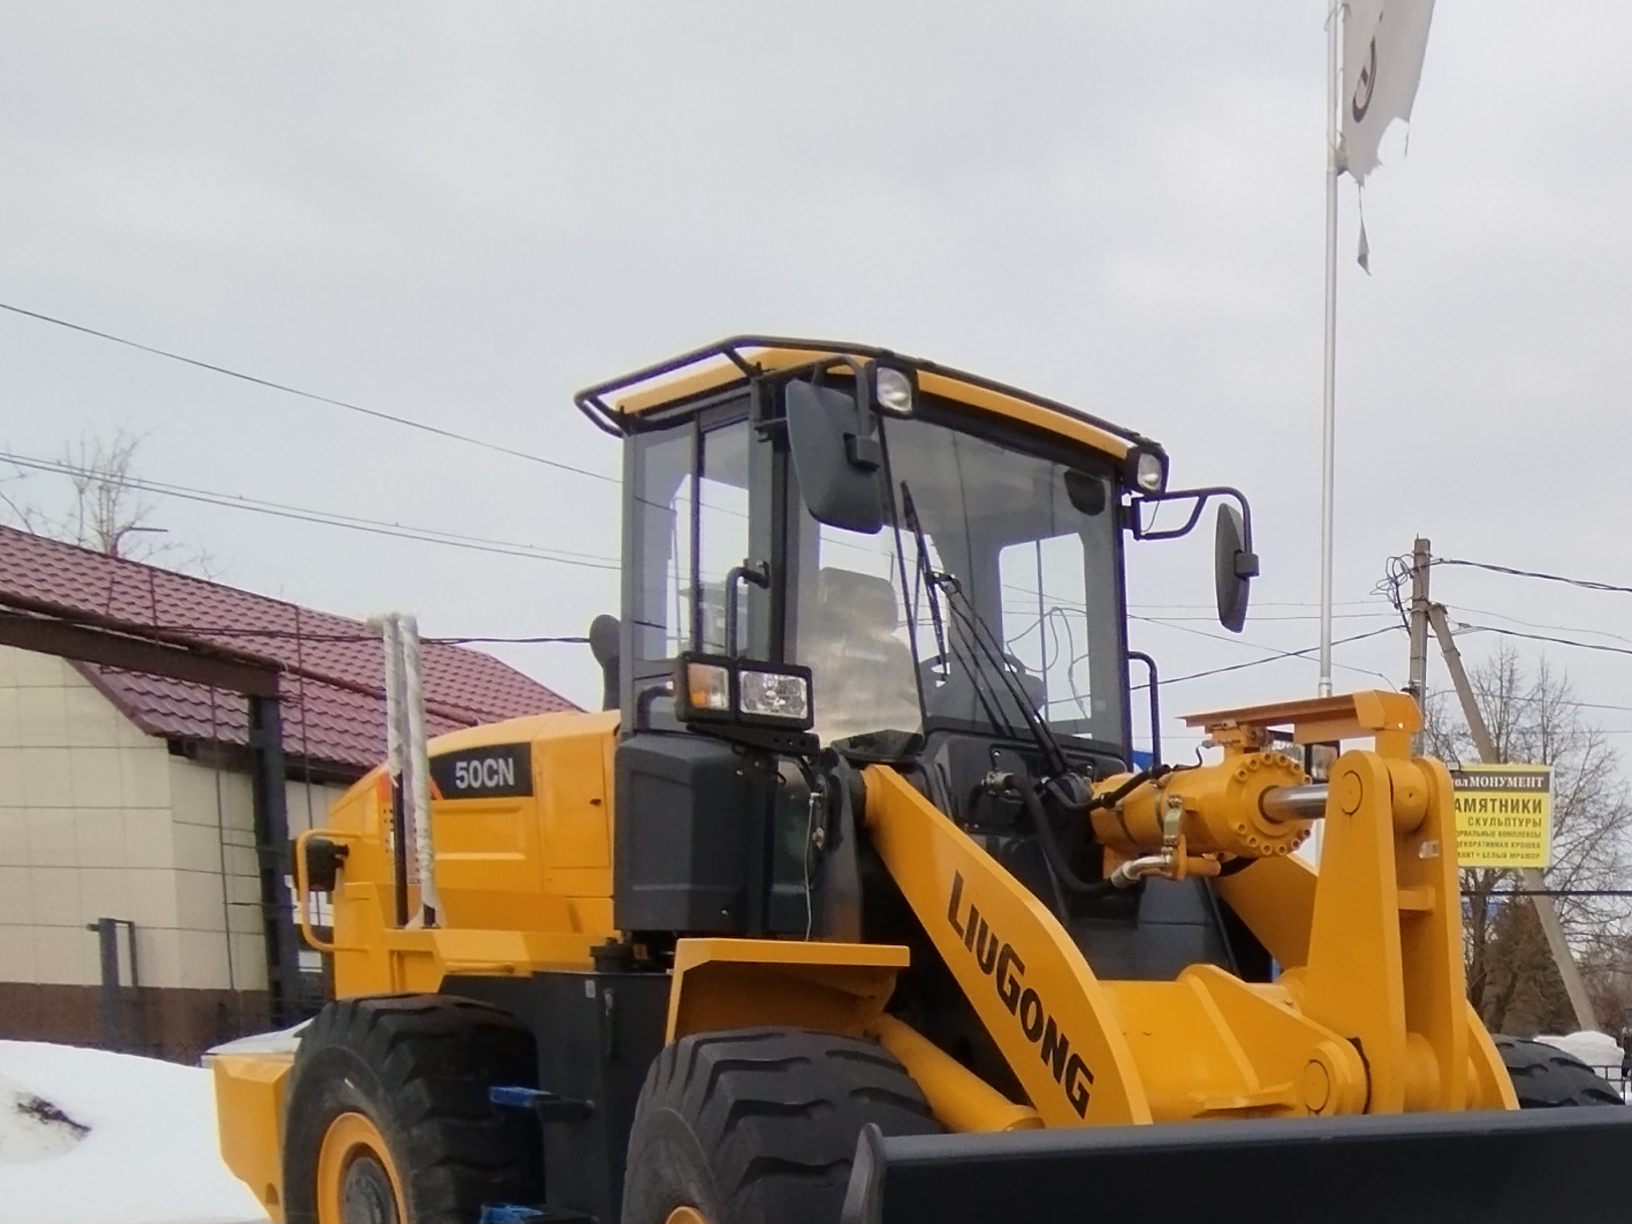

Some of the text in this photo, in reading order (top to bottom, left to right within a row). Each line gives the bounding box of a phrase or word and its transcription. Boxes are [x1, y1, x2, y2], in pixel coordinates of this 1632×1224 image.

[455, 757, 515, 789] 50CN
[1453, 776, 1544, 788] олМОНУМЕНТ
[1455, 798, 1542, 814] АМЯТНИКИ
[1468, 817, 1542, 828] СКУЛЬПТУРЫ
[1511, 841, 1541, 849] КРОШКА
[946, 869, 1095, 1120] LIUGONG
